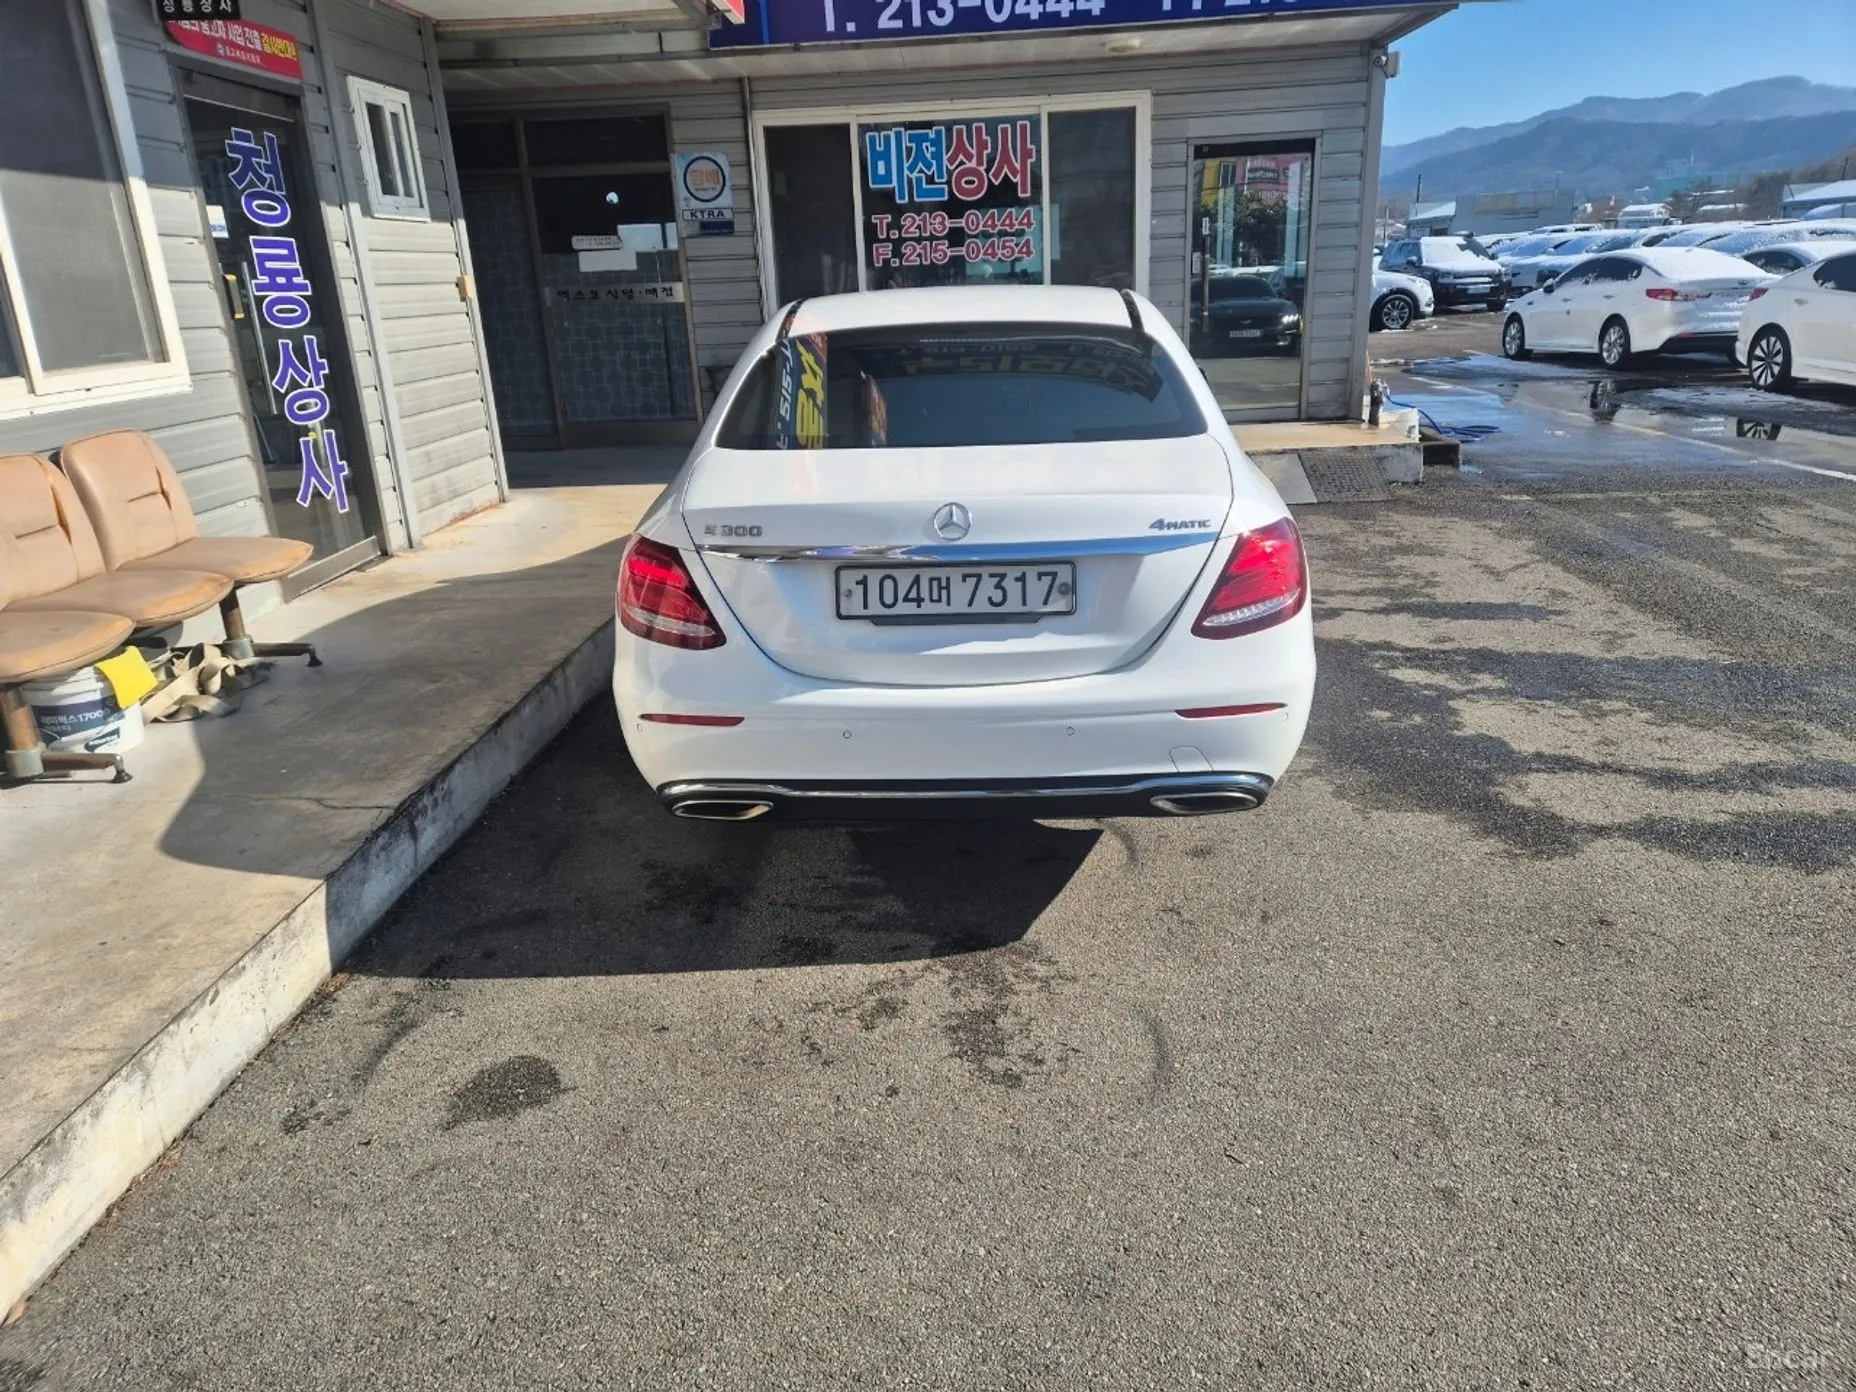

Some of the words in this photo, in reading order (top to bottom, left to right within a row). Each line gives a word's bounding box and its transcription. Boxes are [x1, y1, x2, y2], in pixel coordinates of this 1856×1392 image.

[866, 121, 1036, 203] 비젼상사
[872, 208, 1034, 238] T.213-0444
[873, 237, 1034, 266] F.215-0454
[225, 127, 350, 513] 청룡상사
[721, 525, 762, 536] 300
[1149, 518, 1212, 530] 4MATIC
[961, 571, 1058, 607] 7317
